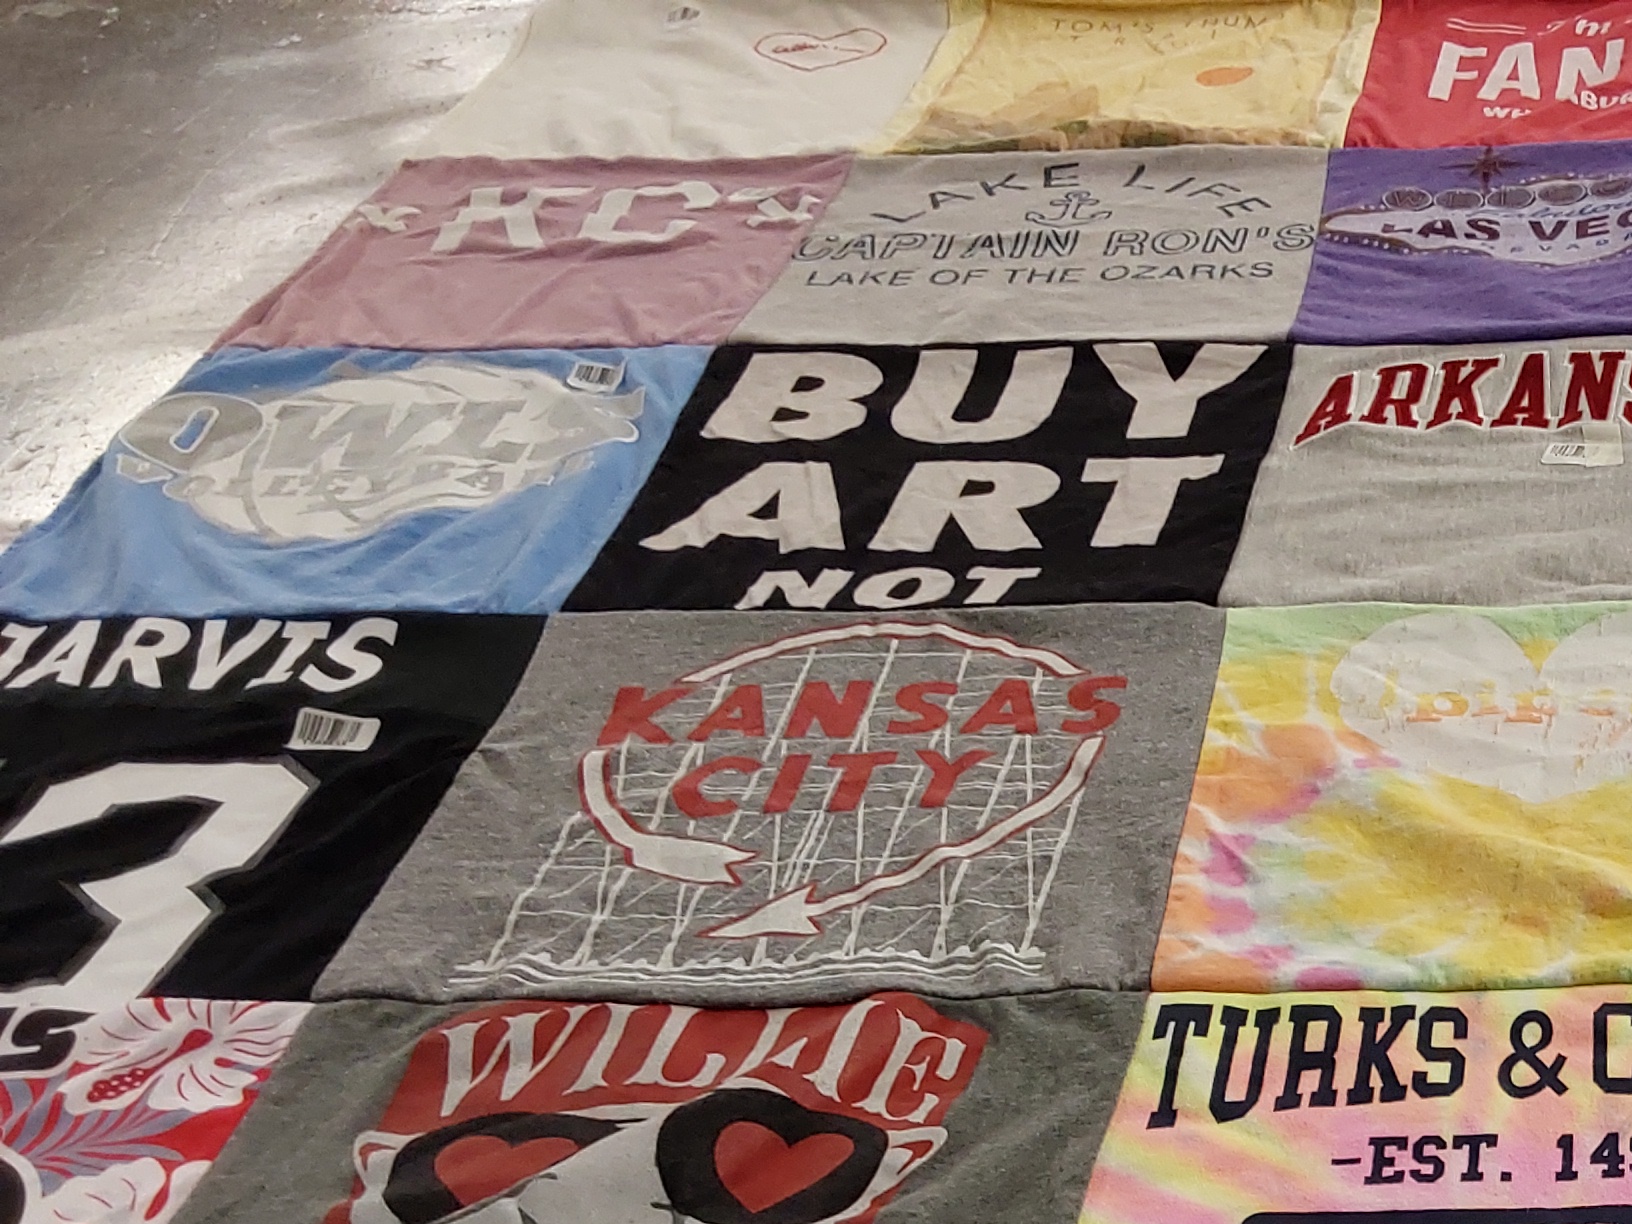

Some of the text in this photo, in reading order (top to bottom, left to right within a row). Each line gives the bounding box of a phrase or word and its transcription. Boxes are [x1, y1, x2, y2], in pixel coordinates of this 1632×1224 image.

[431, 180, 723, 253] KC
[871, 162, 1273, 224] LAKE LIFE
[791, 222, 1317, 261] CAPTAIN RON'S
[1381, 219, 1501, 240] LAS
[804, 261, 1276, 288] LAKE OF THE OZARKS
[699, 343, 1268, 443] BUY
[638, 453, 1225, 552] ART
[734, 566, 1042, 610] NOT
[597, 675, 1129, 746] KANSAS
[672, 749, 998, 818] CITY
[440, 999, 968, 1124] WILLIE
[1145, 1002, 1469, 1130] TURKS
[1496, 1008, 1570, 1098] &
